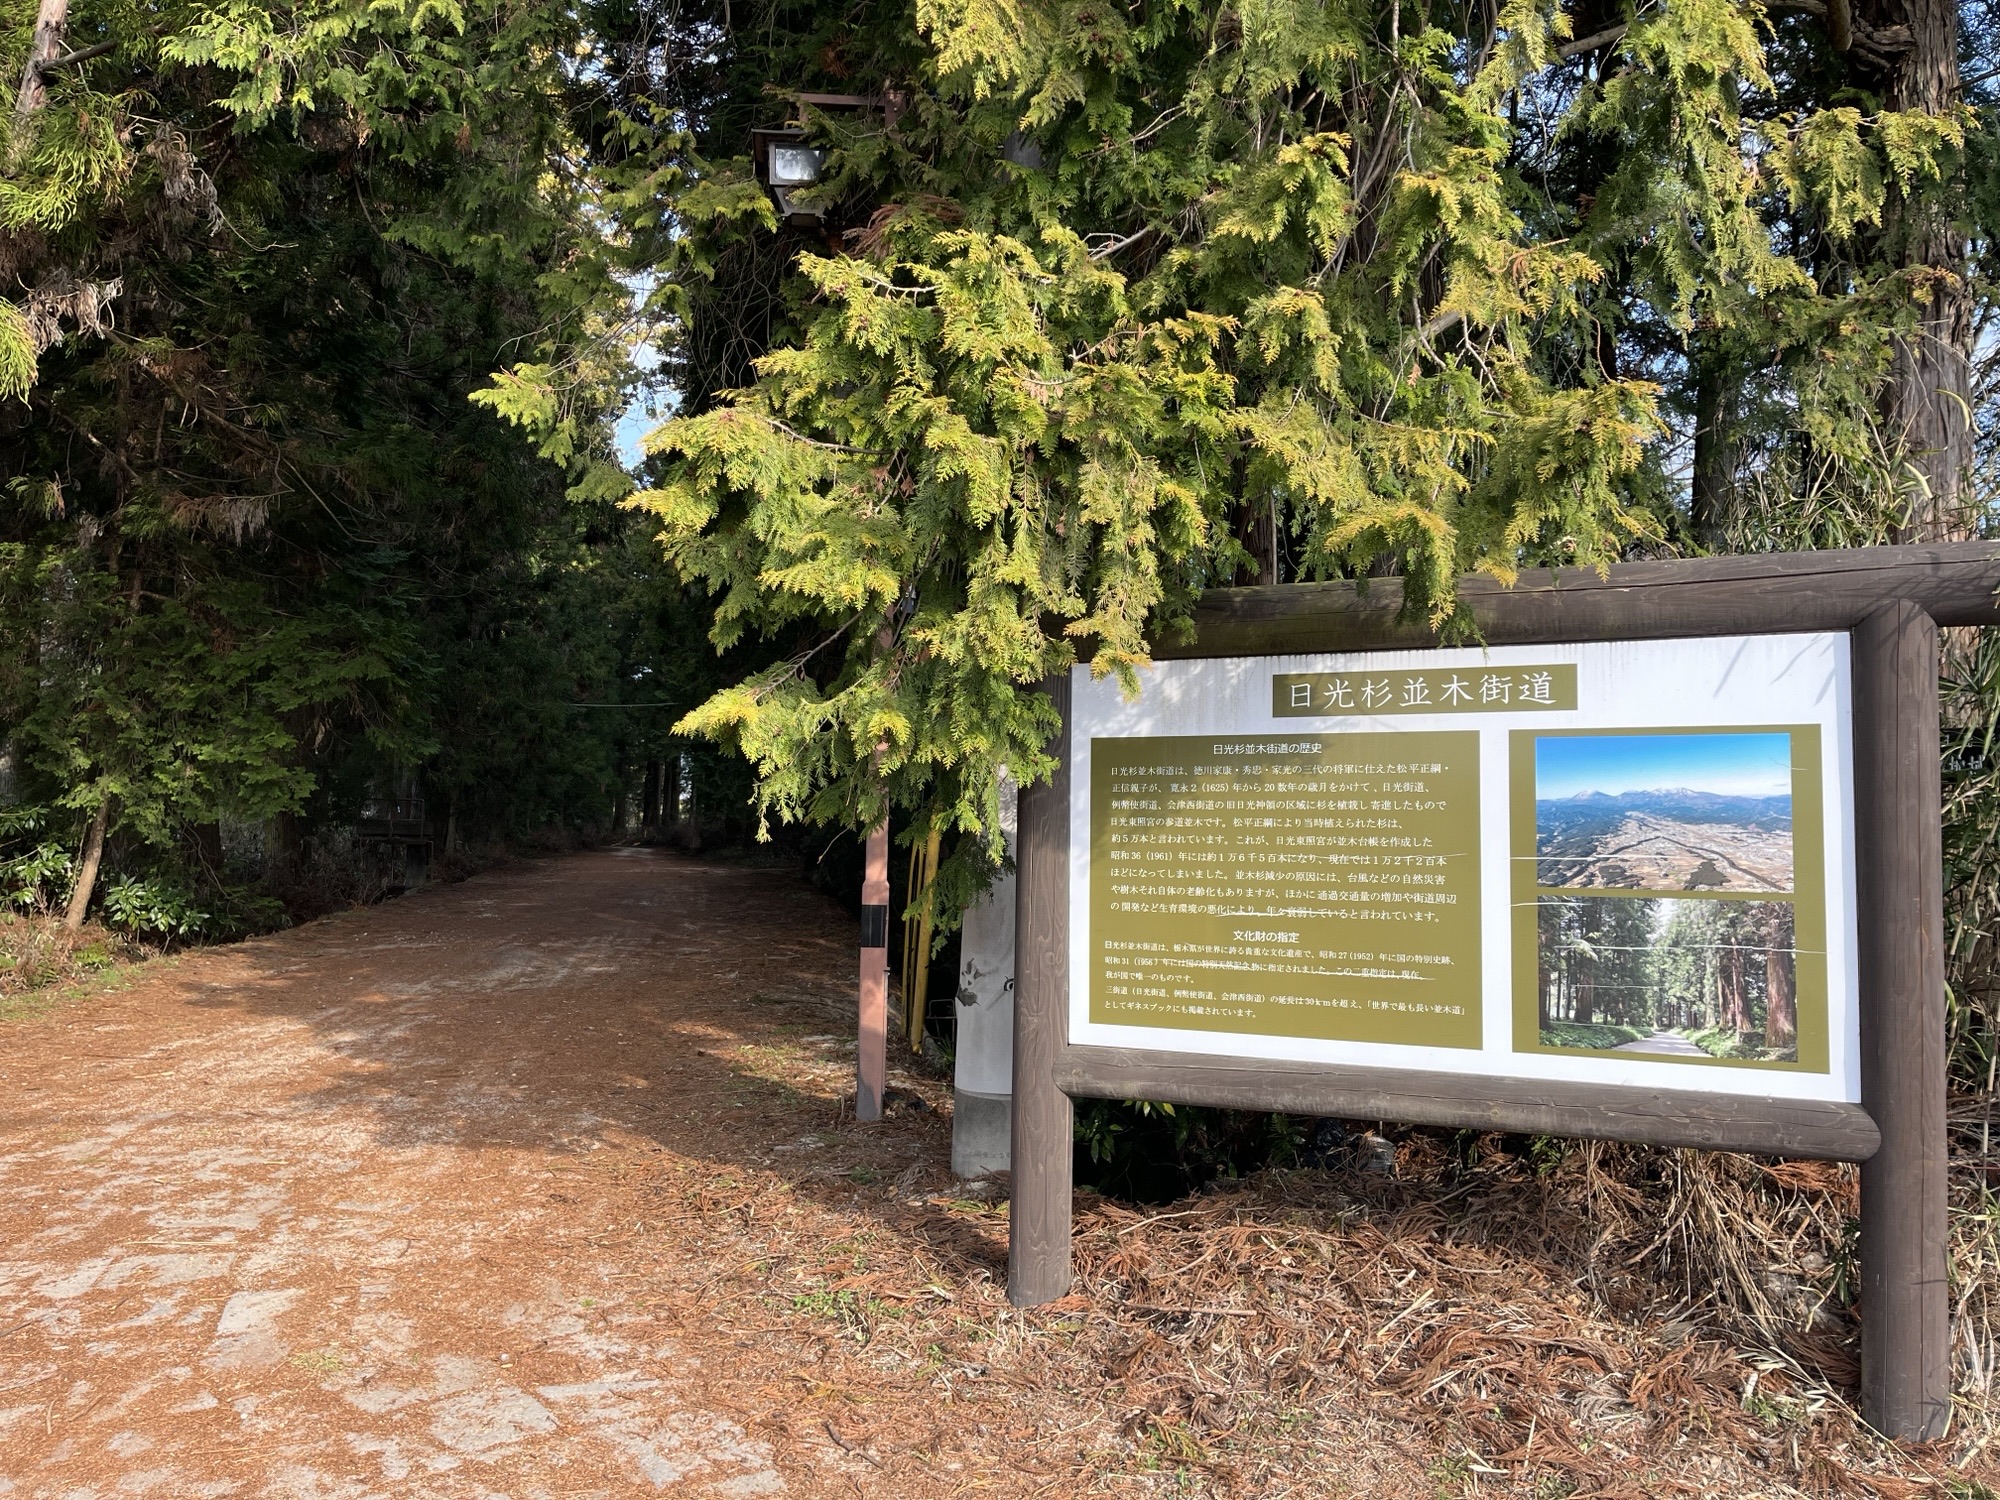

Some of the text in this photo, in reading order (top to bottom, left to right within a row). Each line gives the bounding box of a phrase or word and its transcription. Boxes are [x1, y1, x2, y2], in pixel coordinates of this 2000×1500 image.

[1288, 671, 1557, 709] 日光杉並木街道
[1213, 743, 1322, 755] 日光杉並木街道の歴史
[1233, 930, 1300, 943] 文化財の指定
